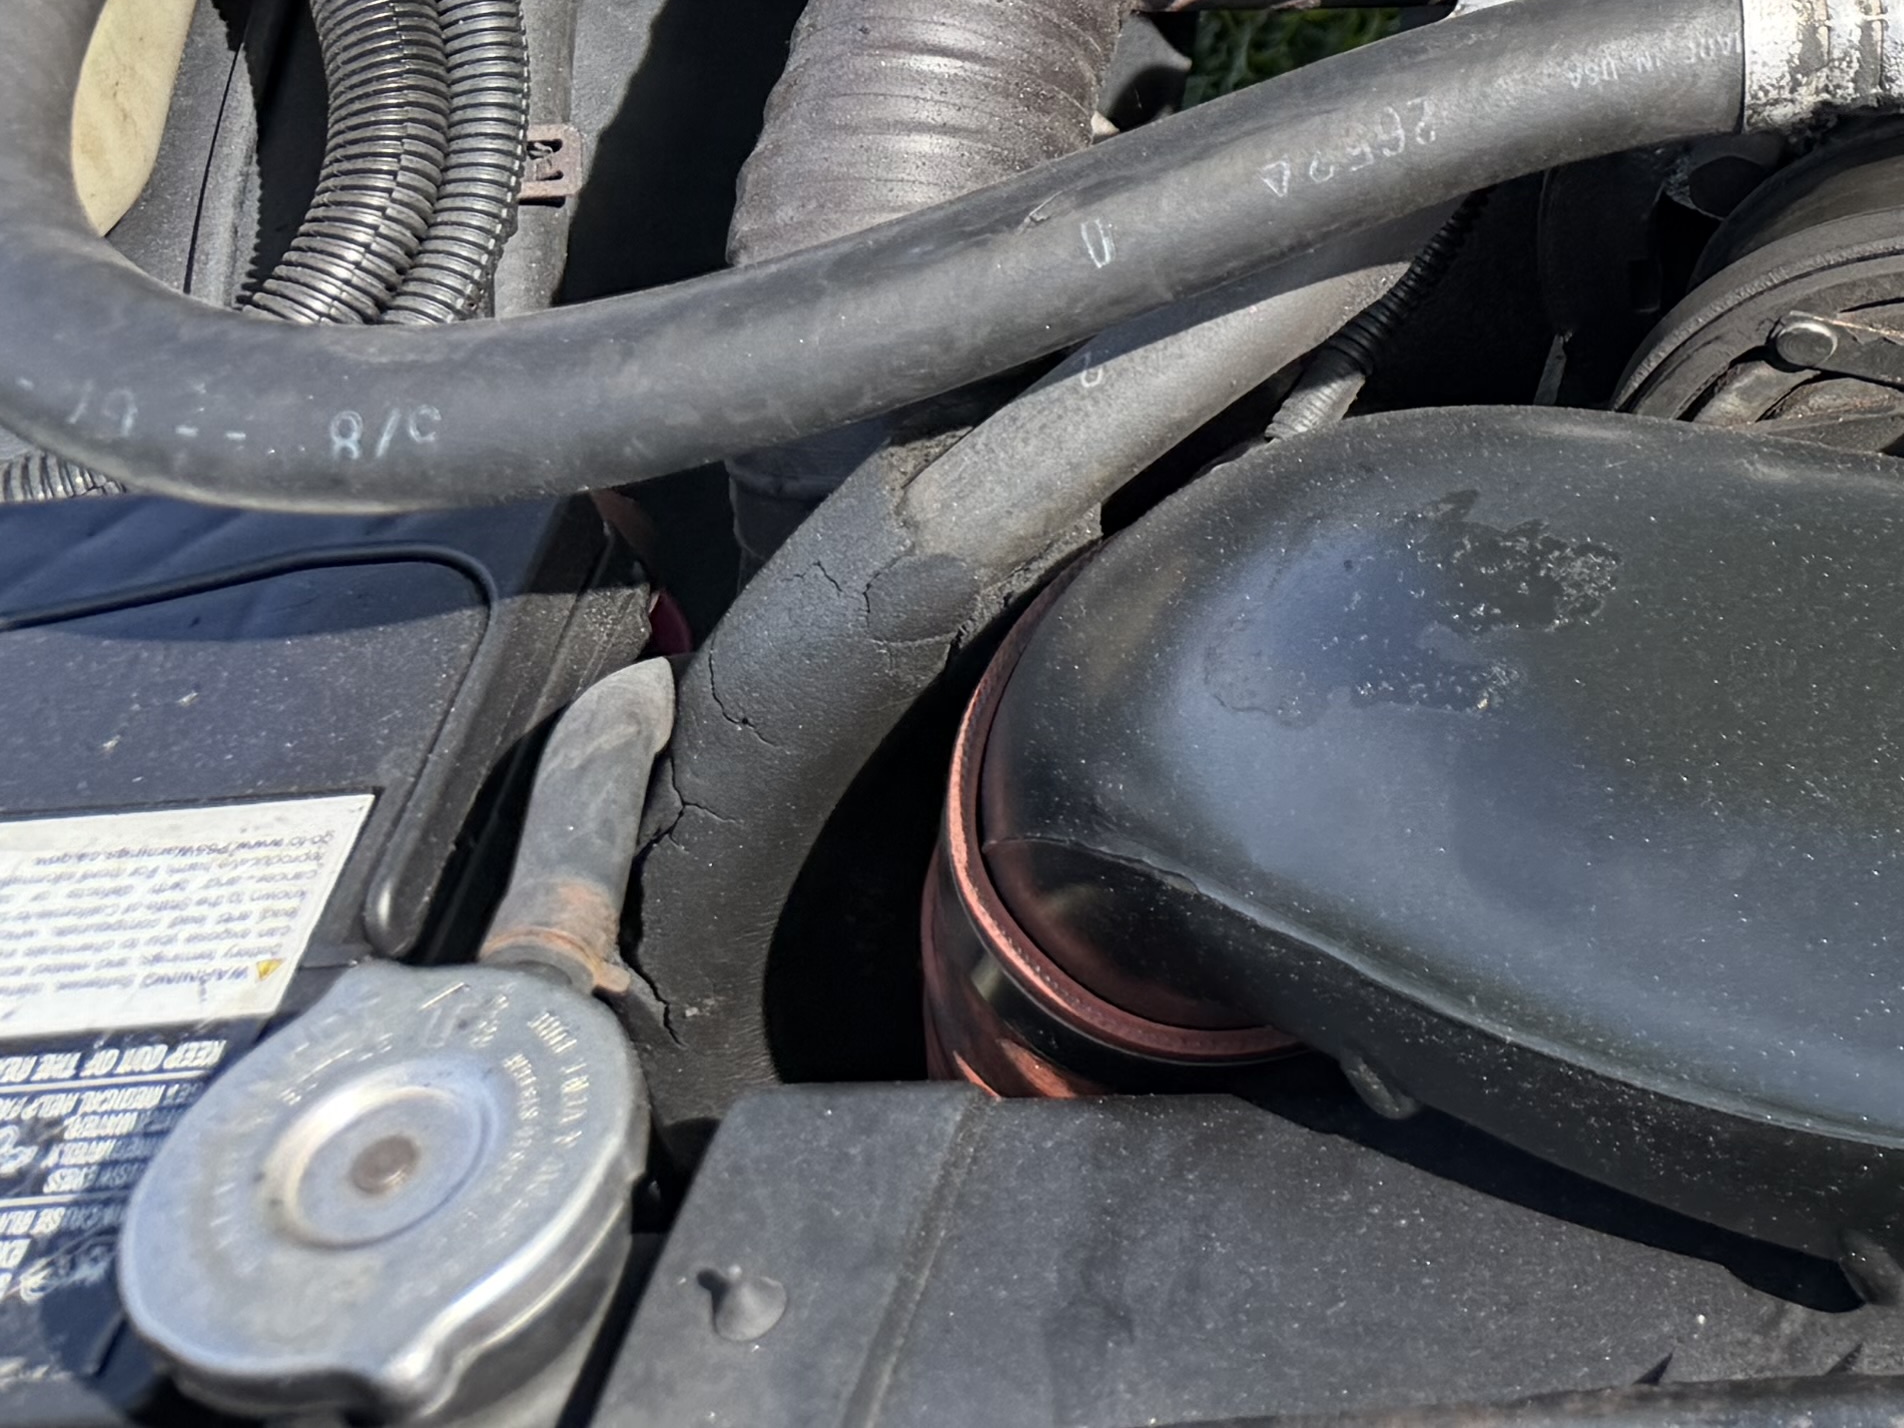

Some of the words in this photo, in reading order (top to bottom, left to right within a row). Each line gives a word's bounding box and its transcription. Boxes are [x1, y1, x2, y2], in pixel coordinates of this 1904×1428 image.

[30, 1052, 81, 1080] THE
[78, 1049, 119, 1076] OF
[114, 1044, 168, 1073] OUT
[161, 1042, 224, 1068] KEEP
[20, 1093, 80, 1118] HELP
[76, 1085, 165, 1111] MEDICAL
